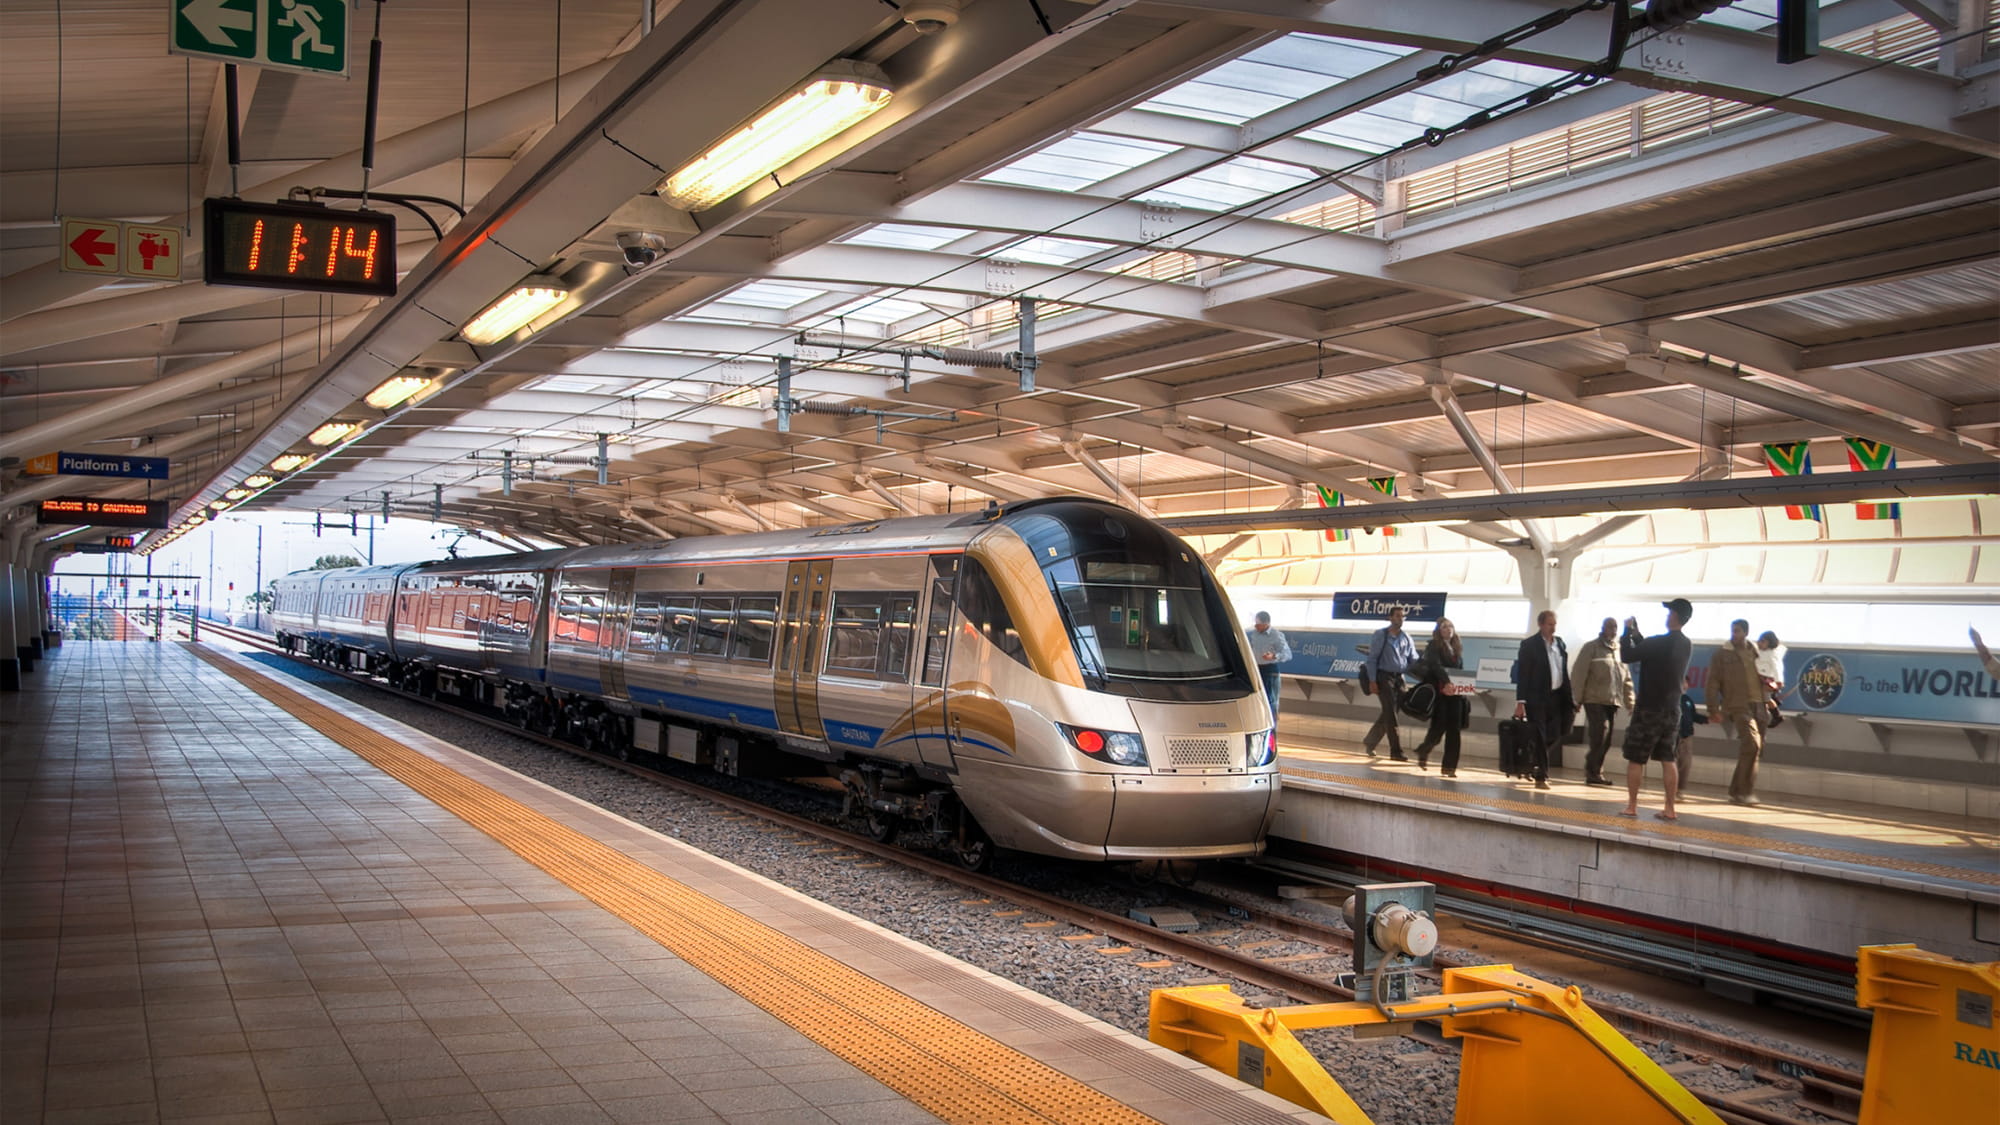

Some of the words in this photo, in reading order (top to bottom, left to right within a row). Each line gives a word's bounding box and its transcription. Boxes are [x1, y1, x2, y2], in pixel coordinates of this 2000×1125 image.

[247, 219, 378, 280] 11:14
[63, 458, 119, 472] Platform
[122, 461, 131, 472] B
[43, 500, 83, 511] WELCOME
[86, 502, 99, 512] TO
[102, 503, 147, 515] GAUTRAIN
[1800, 668, 1843, 686] AFRICA
[1860, 677, 1873, 692] to
[1876, 680, 1899, 693] the
